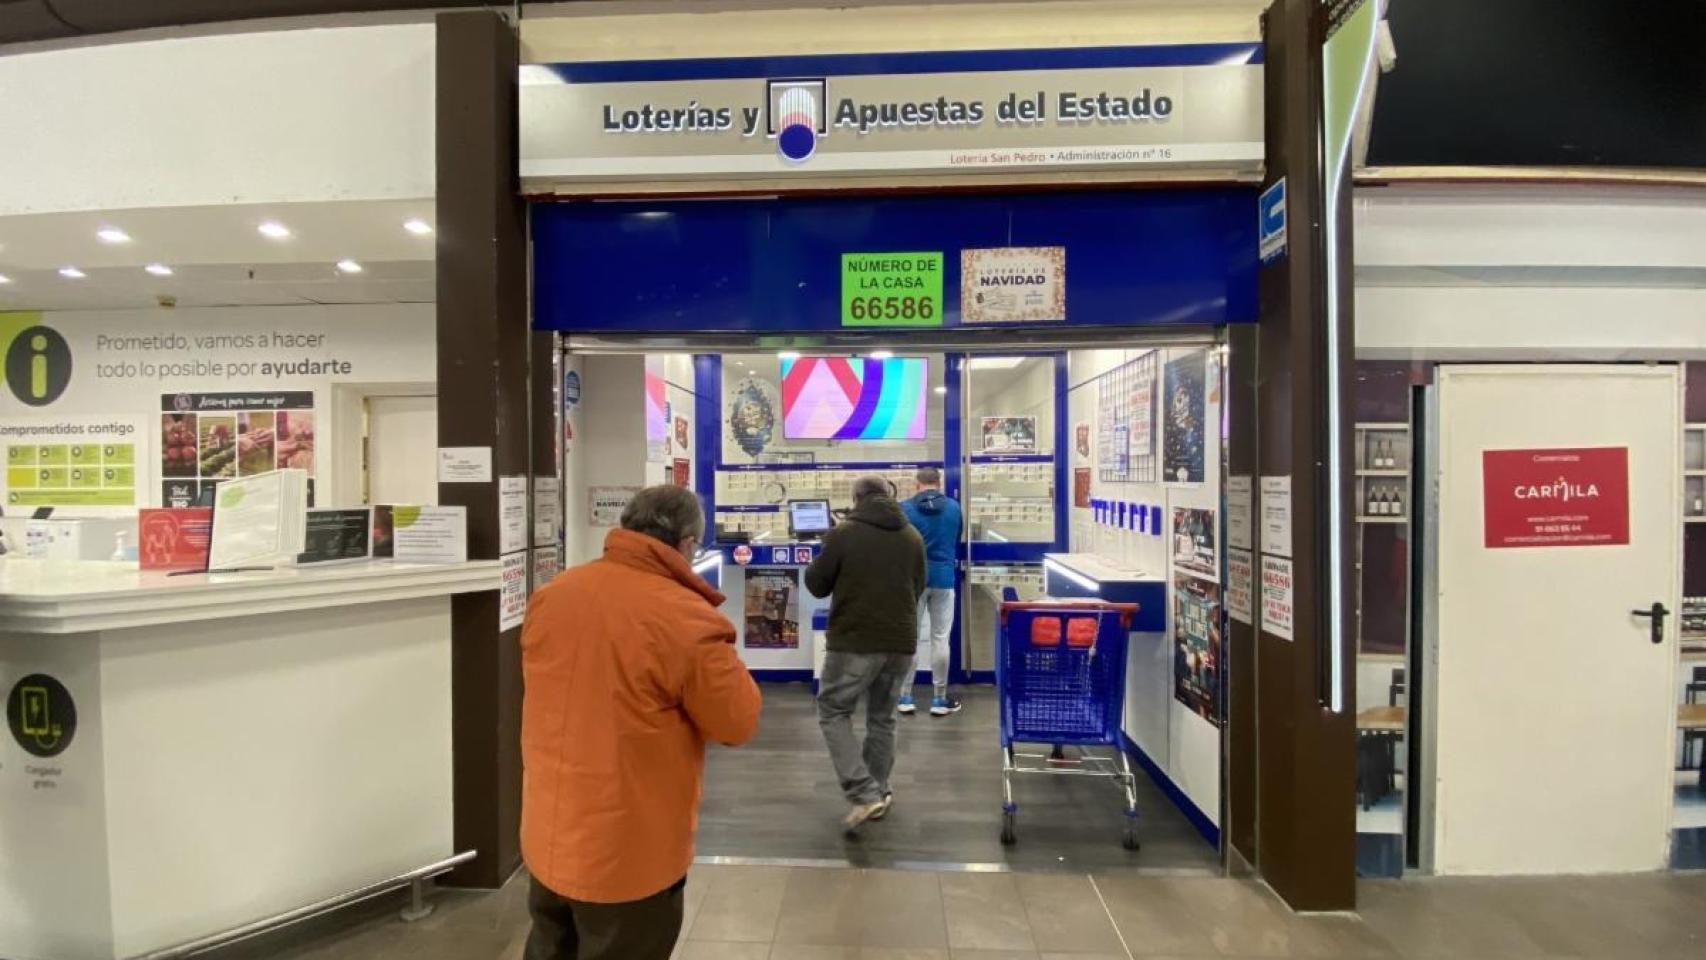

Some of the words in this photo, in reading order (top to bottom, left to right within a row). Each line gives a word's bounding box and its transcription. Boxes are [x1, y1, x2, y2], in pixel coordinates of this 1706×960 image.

[603, 102, 731, 134] Loterías
[742, 106, 760, 137] y
[835, 96, 984, 130] Apuestas
[997, 91, 1045, 122] del
[1058, 89, 1173, 120] Estado
[991, 152, 1010, 163] San
[1014, 151, 1046, 163] Pedro
[1057, 149, 1140, 161] Administración
[1159, 148, 1172, 158] 16
[848, 256, 912, 272] NÚMERO
[917, 259, 936, 271] DE
[860, 278, 878, 289] LA
[883, 276, 924, 289] CASA
[980, 275, 1046, 287] NAVIDAD
[851, 297, 933, 320] 66586
[96, 333, 191, 352] Prometido,
[195, 334, 254, 349] vamos
[258, 336, 269, 348] a
[273, 331, 325, 348] hacer
[96, 362, 136, 378] todo
[140, 361, 155, 377] lo
[159, 360, 223, 381] posible
[227, 363, 257, 382] por
[261, 358, 352, 379] ayudarte
[88, 422, 135, 435] contigo
[1514, 478, 1599, 502] CARMILA
